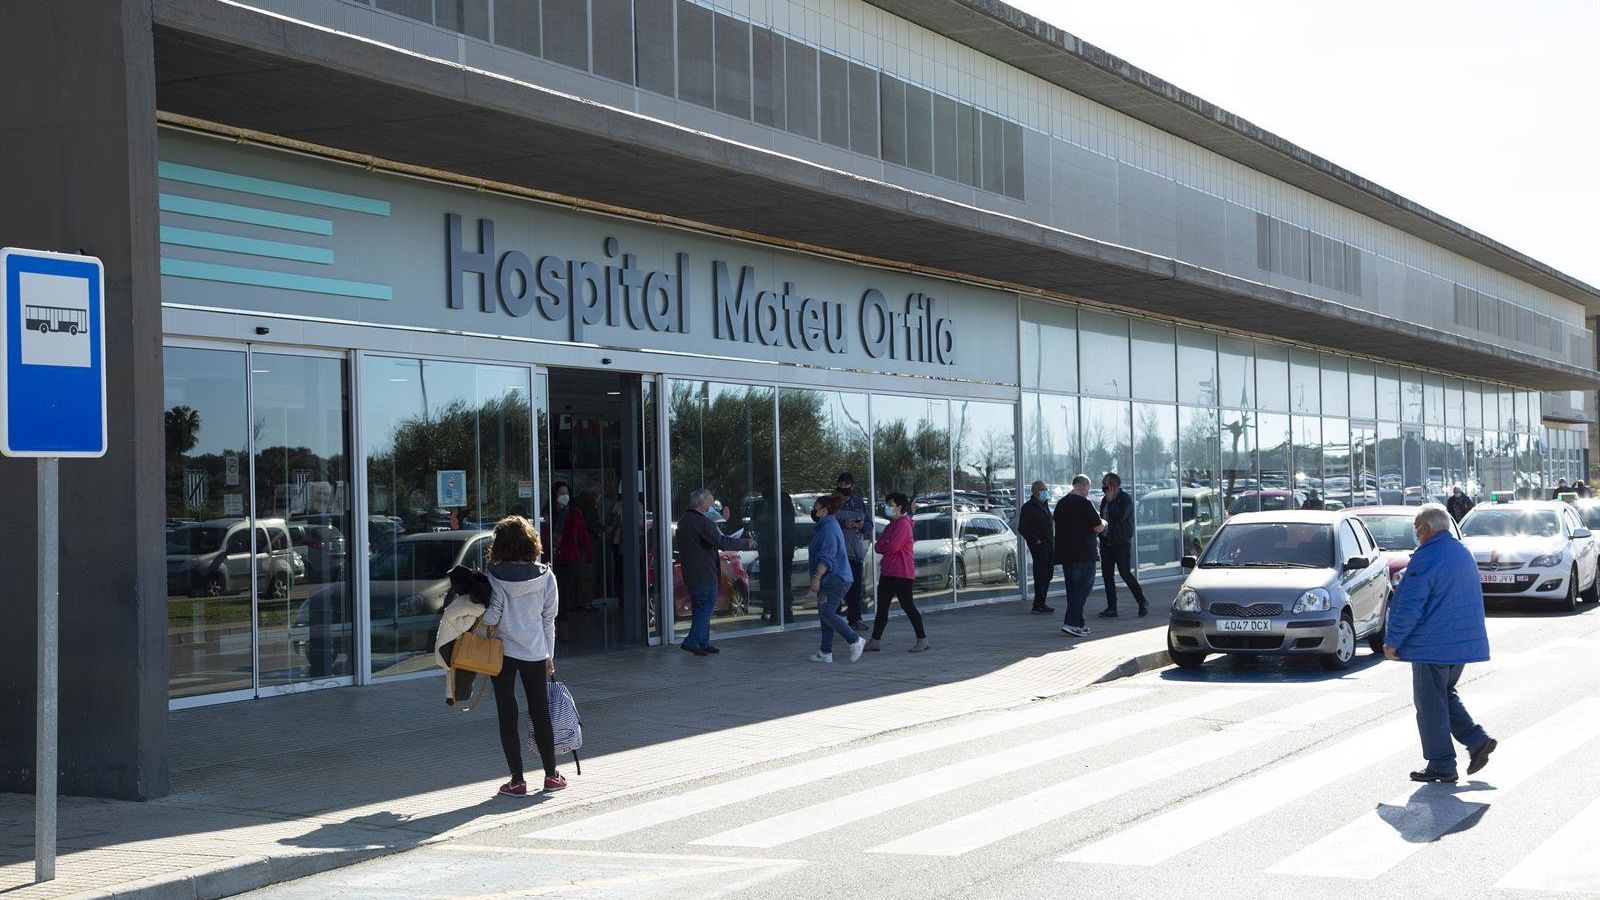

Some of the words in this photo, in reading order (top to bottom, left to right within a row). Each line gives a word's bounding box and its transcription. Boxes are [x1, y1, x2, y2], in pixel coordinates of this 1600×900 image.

[444, 213, 690, 342] Hospital
[712, 260, 848, 354] Mateu
[858, 288, 958, 365] Orfila
[1224, 620, 1249, 631] 4047
[1250, 620, 1270, 631] DCX
